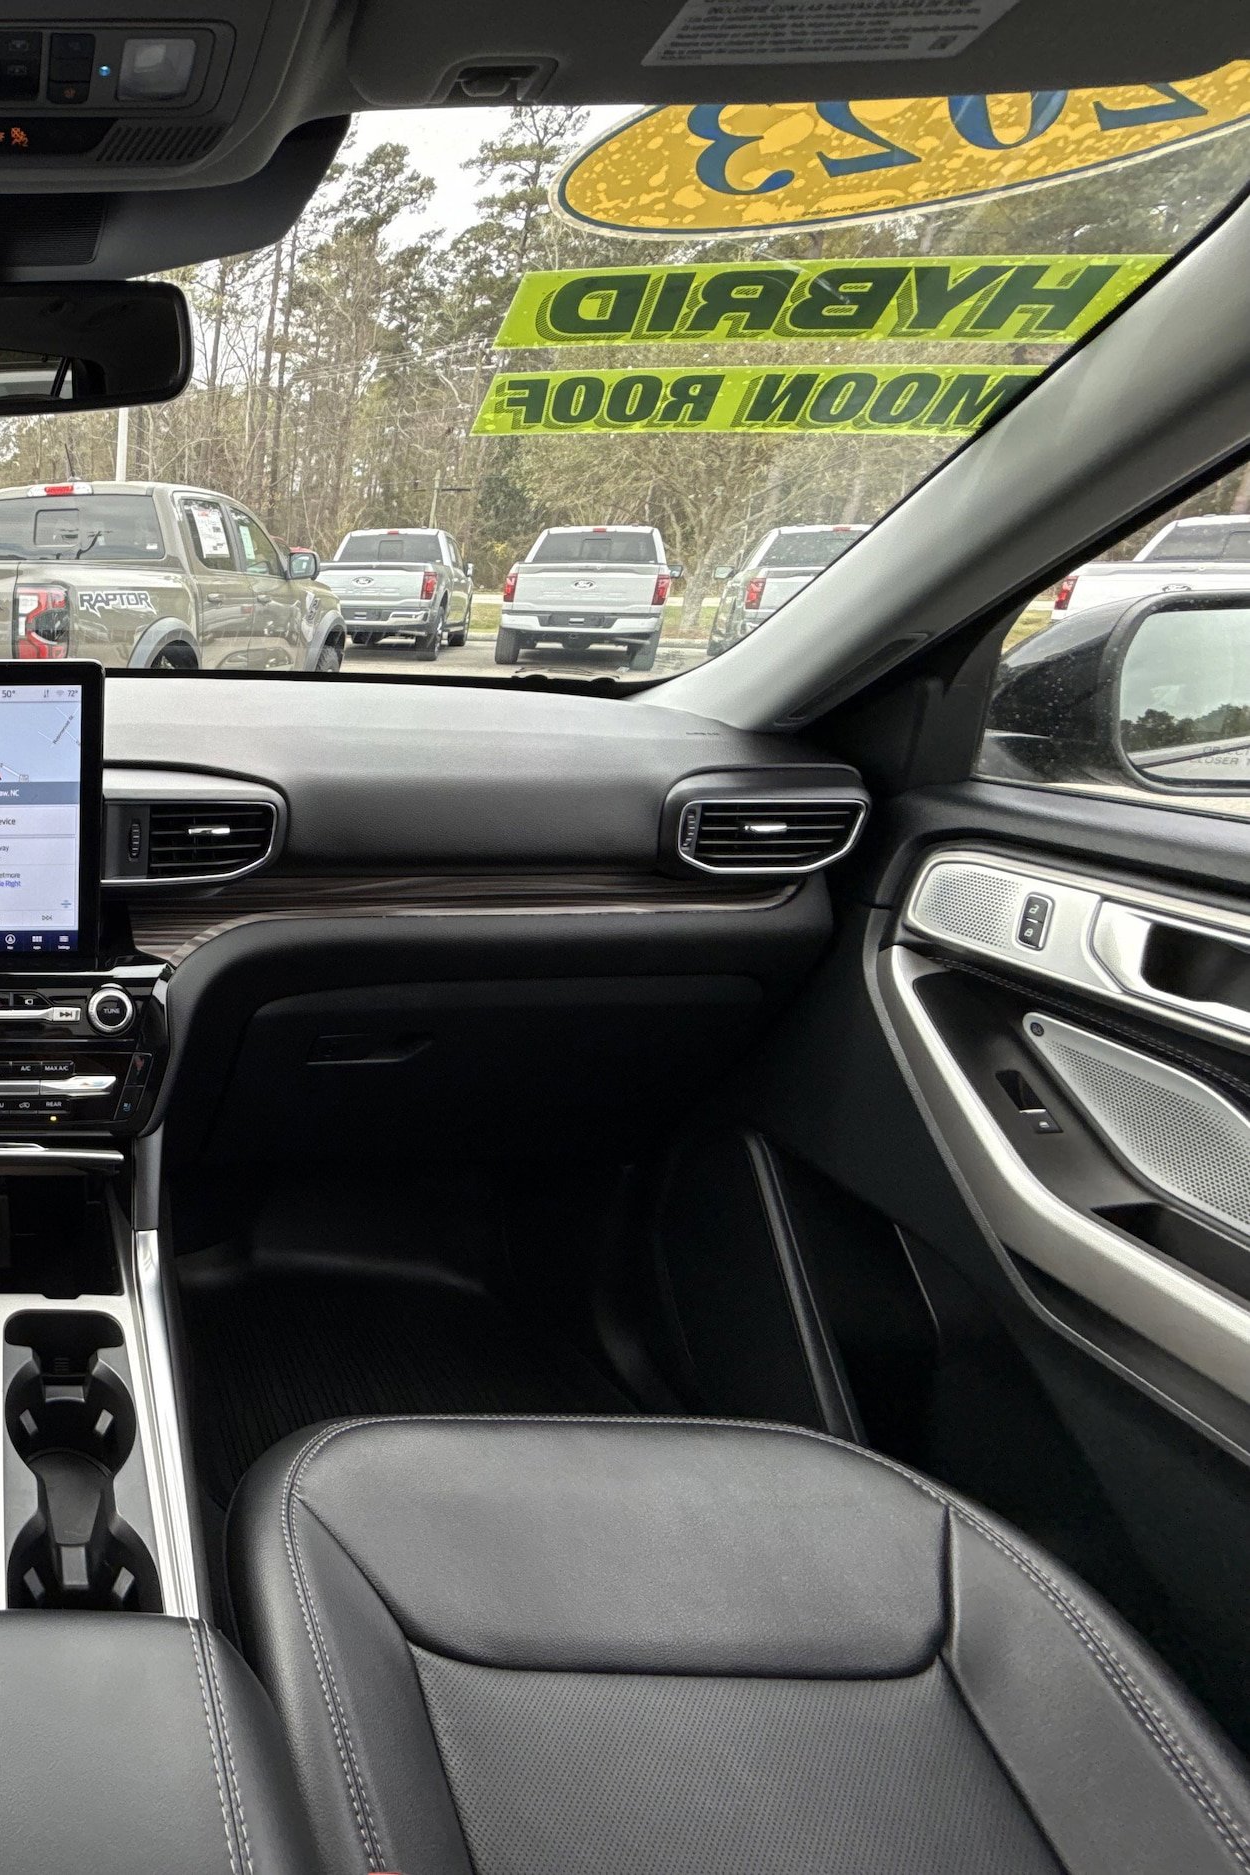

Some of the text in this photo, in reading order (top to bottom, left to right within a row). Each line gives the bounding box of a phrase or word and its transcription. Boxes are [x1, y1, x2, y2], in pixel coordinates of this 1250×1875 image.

[77, 591, 157, 618] RAPTOR
[10, 789, 20, 797] NC
[5, 880, 21, 888] Right
